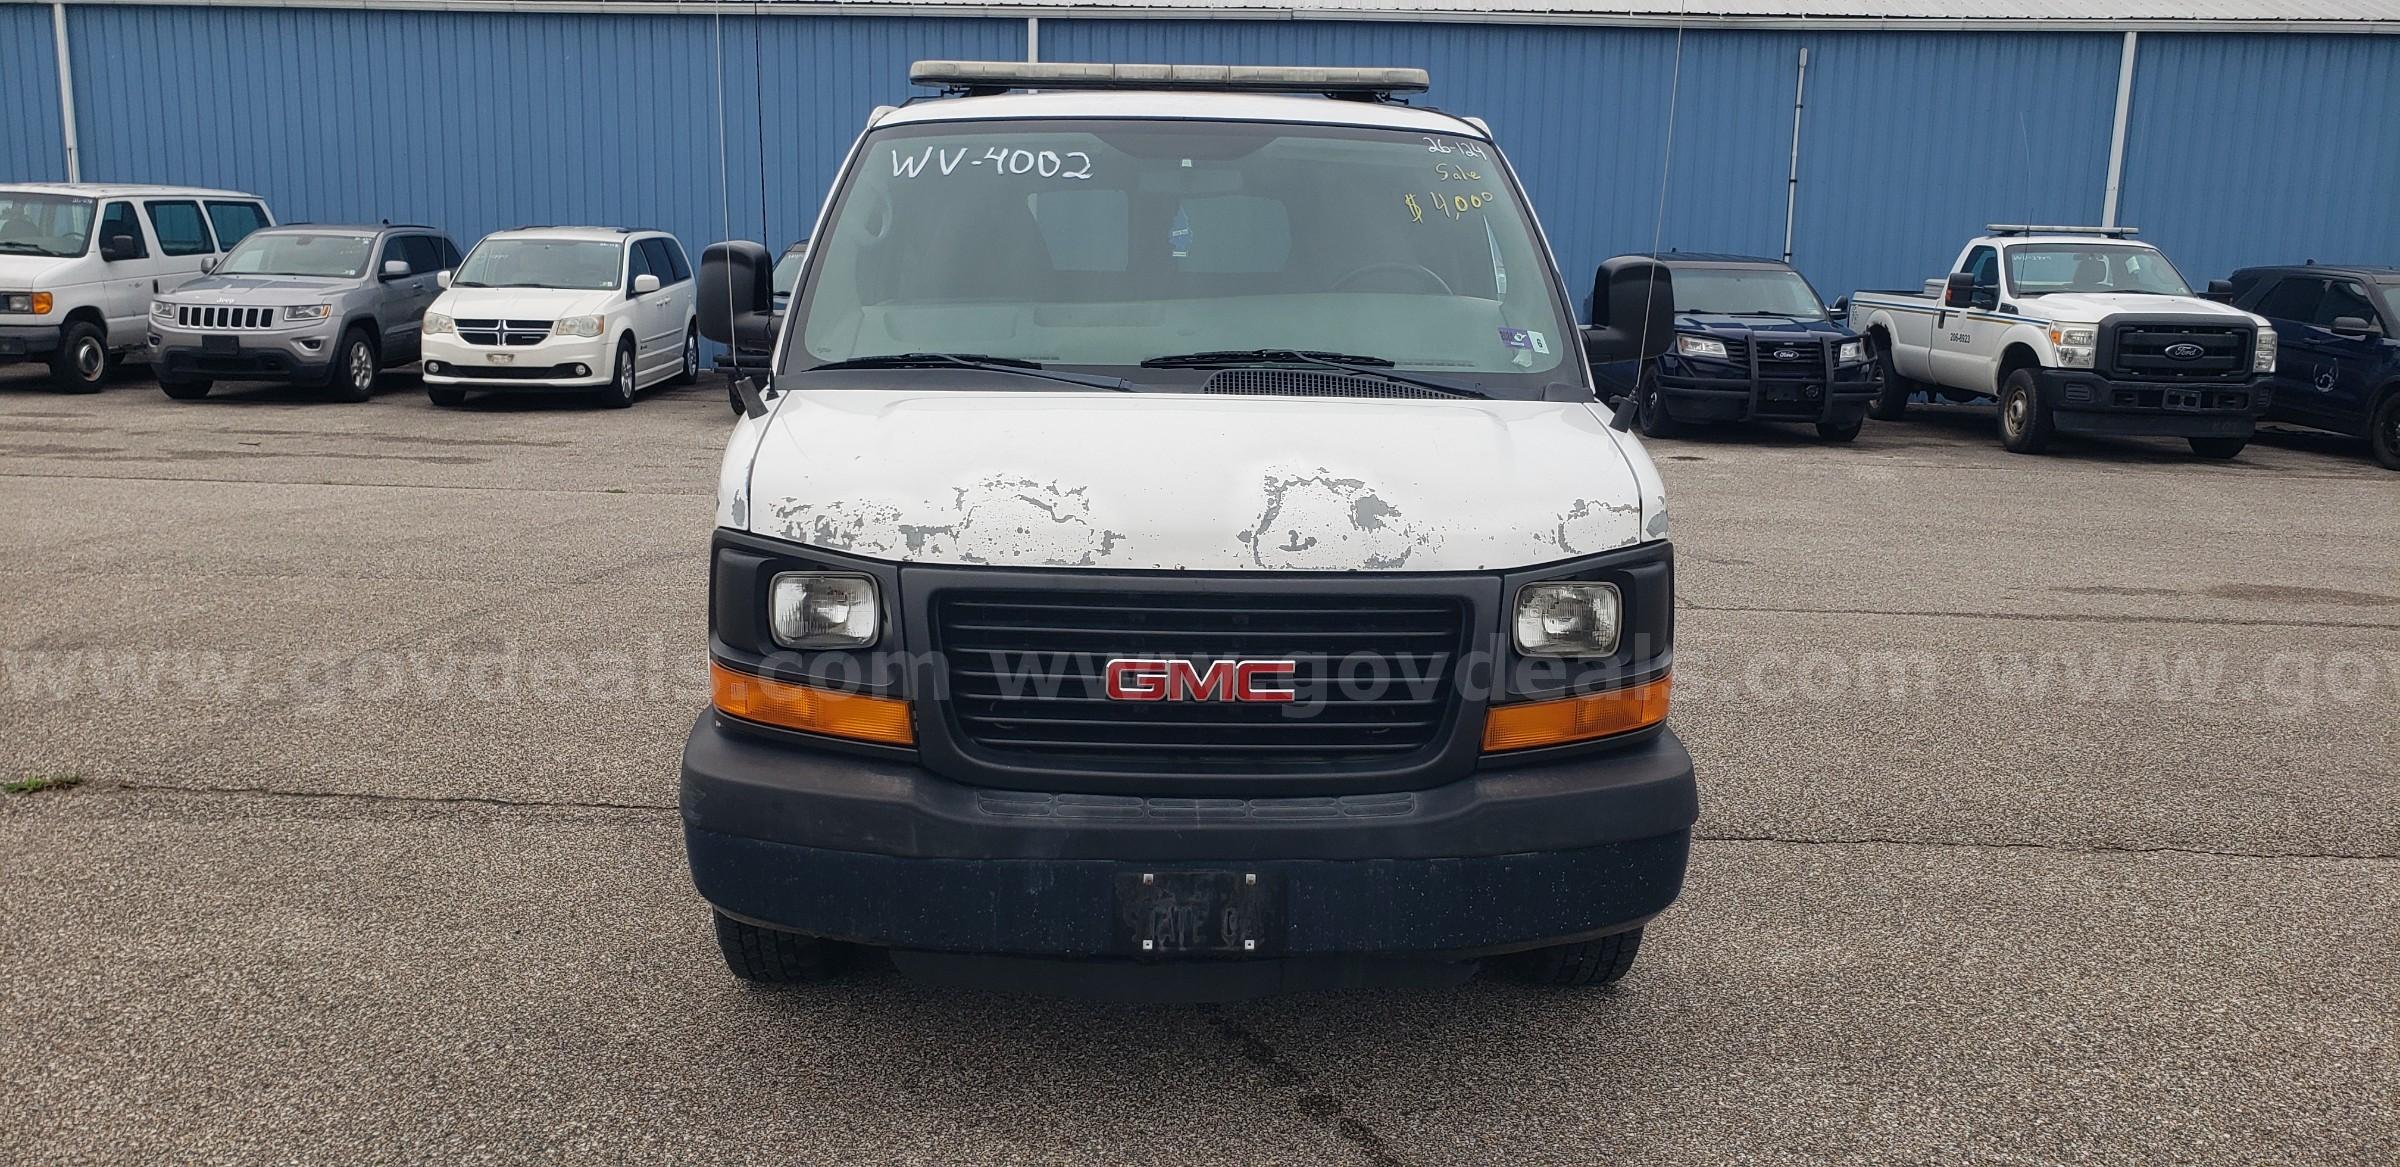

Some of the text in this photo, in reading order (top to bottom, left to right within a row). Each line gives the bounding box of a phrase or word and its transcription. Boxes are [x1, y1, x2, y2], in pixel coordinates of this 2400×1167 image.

[891, 146, 1094, 180] WV-4002
[1435, 163, 1481, 181] Sale
[1105, 658, 1296, 702] GMC
